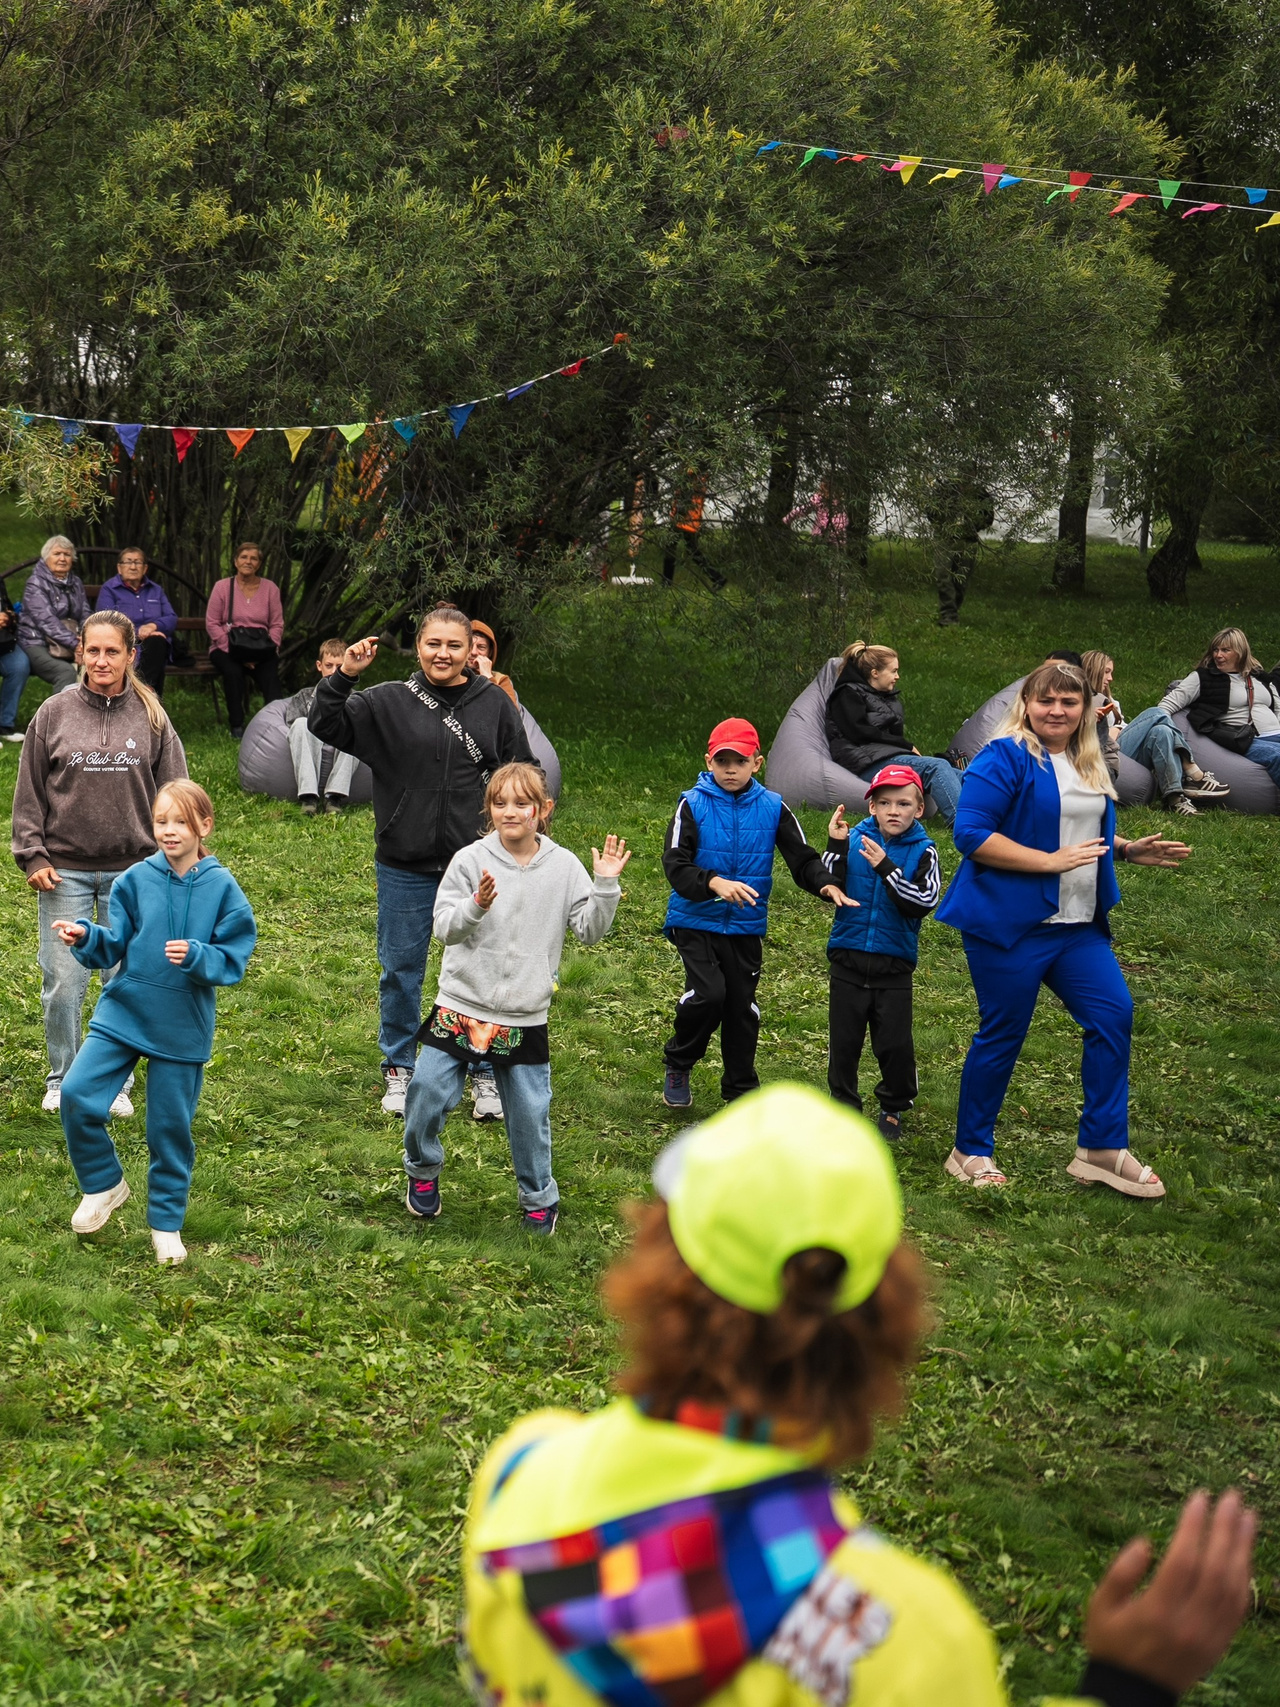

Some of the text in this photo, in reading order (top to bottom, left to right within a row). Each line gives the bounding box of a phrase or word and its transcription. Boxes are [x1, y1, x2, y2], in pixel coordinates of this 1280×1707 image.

[67, 751, 141, 767] Le Club Privé
